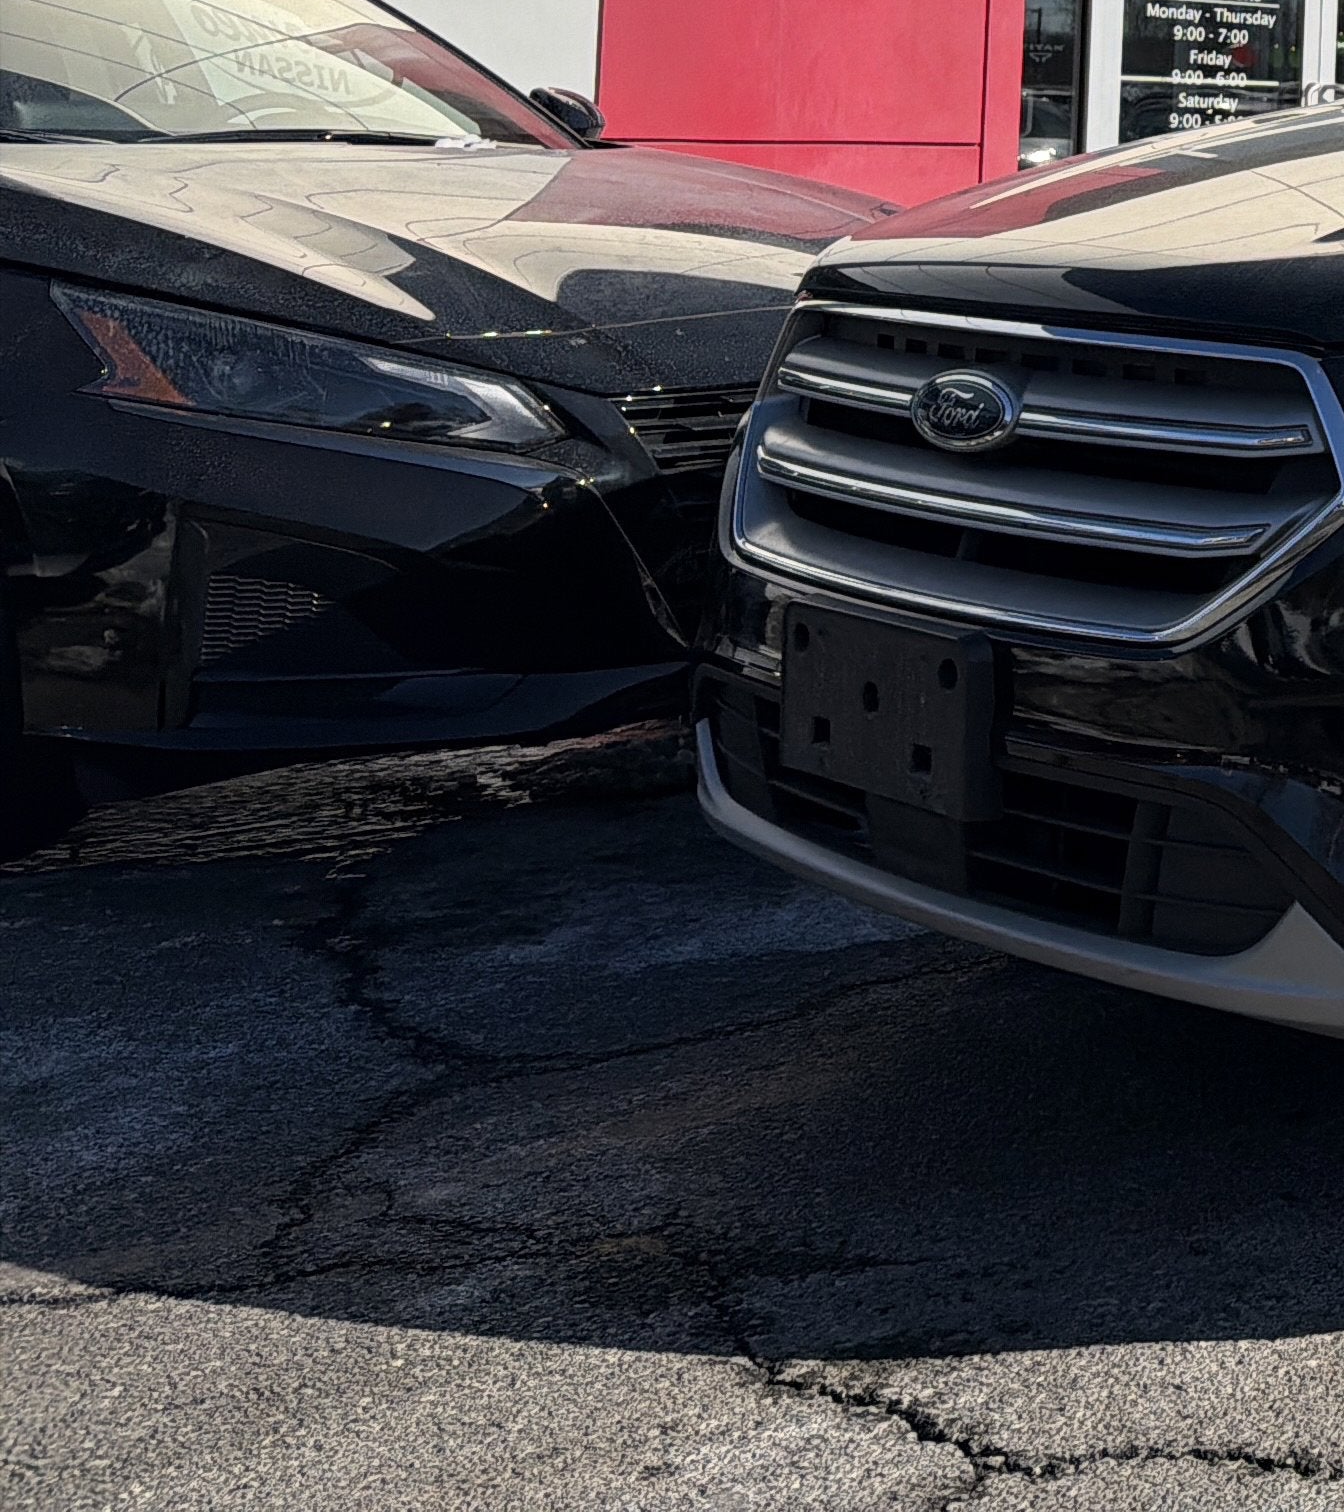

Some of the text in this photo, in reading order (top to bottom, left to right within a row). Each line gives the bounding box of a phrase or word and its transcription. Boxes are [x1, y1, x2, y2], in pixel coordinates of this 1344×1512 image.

[1146, 2, 1202, 23] Monday
[1214, 7, 1276, 29] Thursday
[1173, 25, 1206, 43] 9:00
[1218, 28, 1249, 45] 7:00
[1189, 49, 1232, 69] Friday
[1172, 69, 1204, 85] 9:00
[1216, 71, 1247, 88] 6:00
[1178, 92, 1239, 113] Saturday
[1169, 112, 1202, 129] 9:00
[928, 388, 985, 427] Ford
